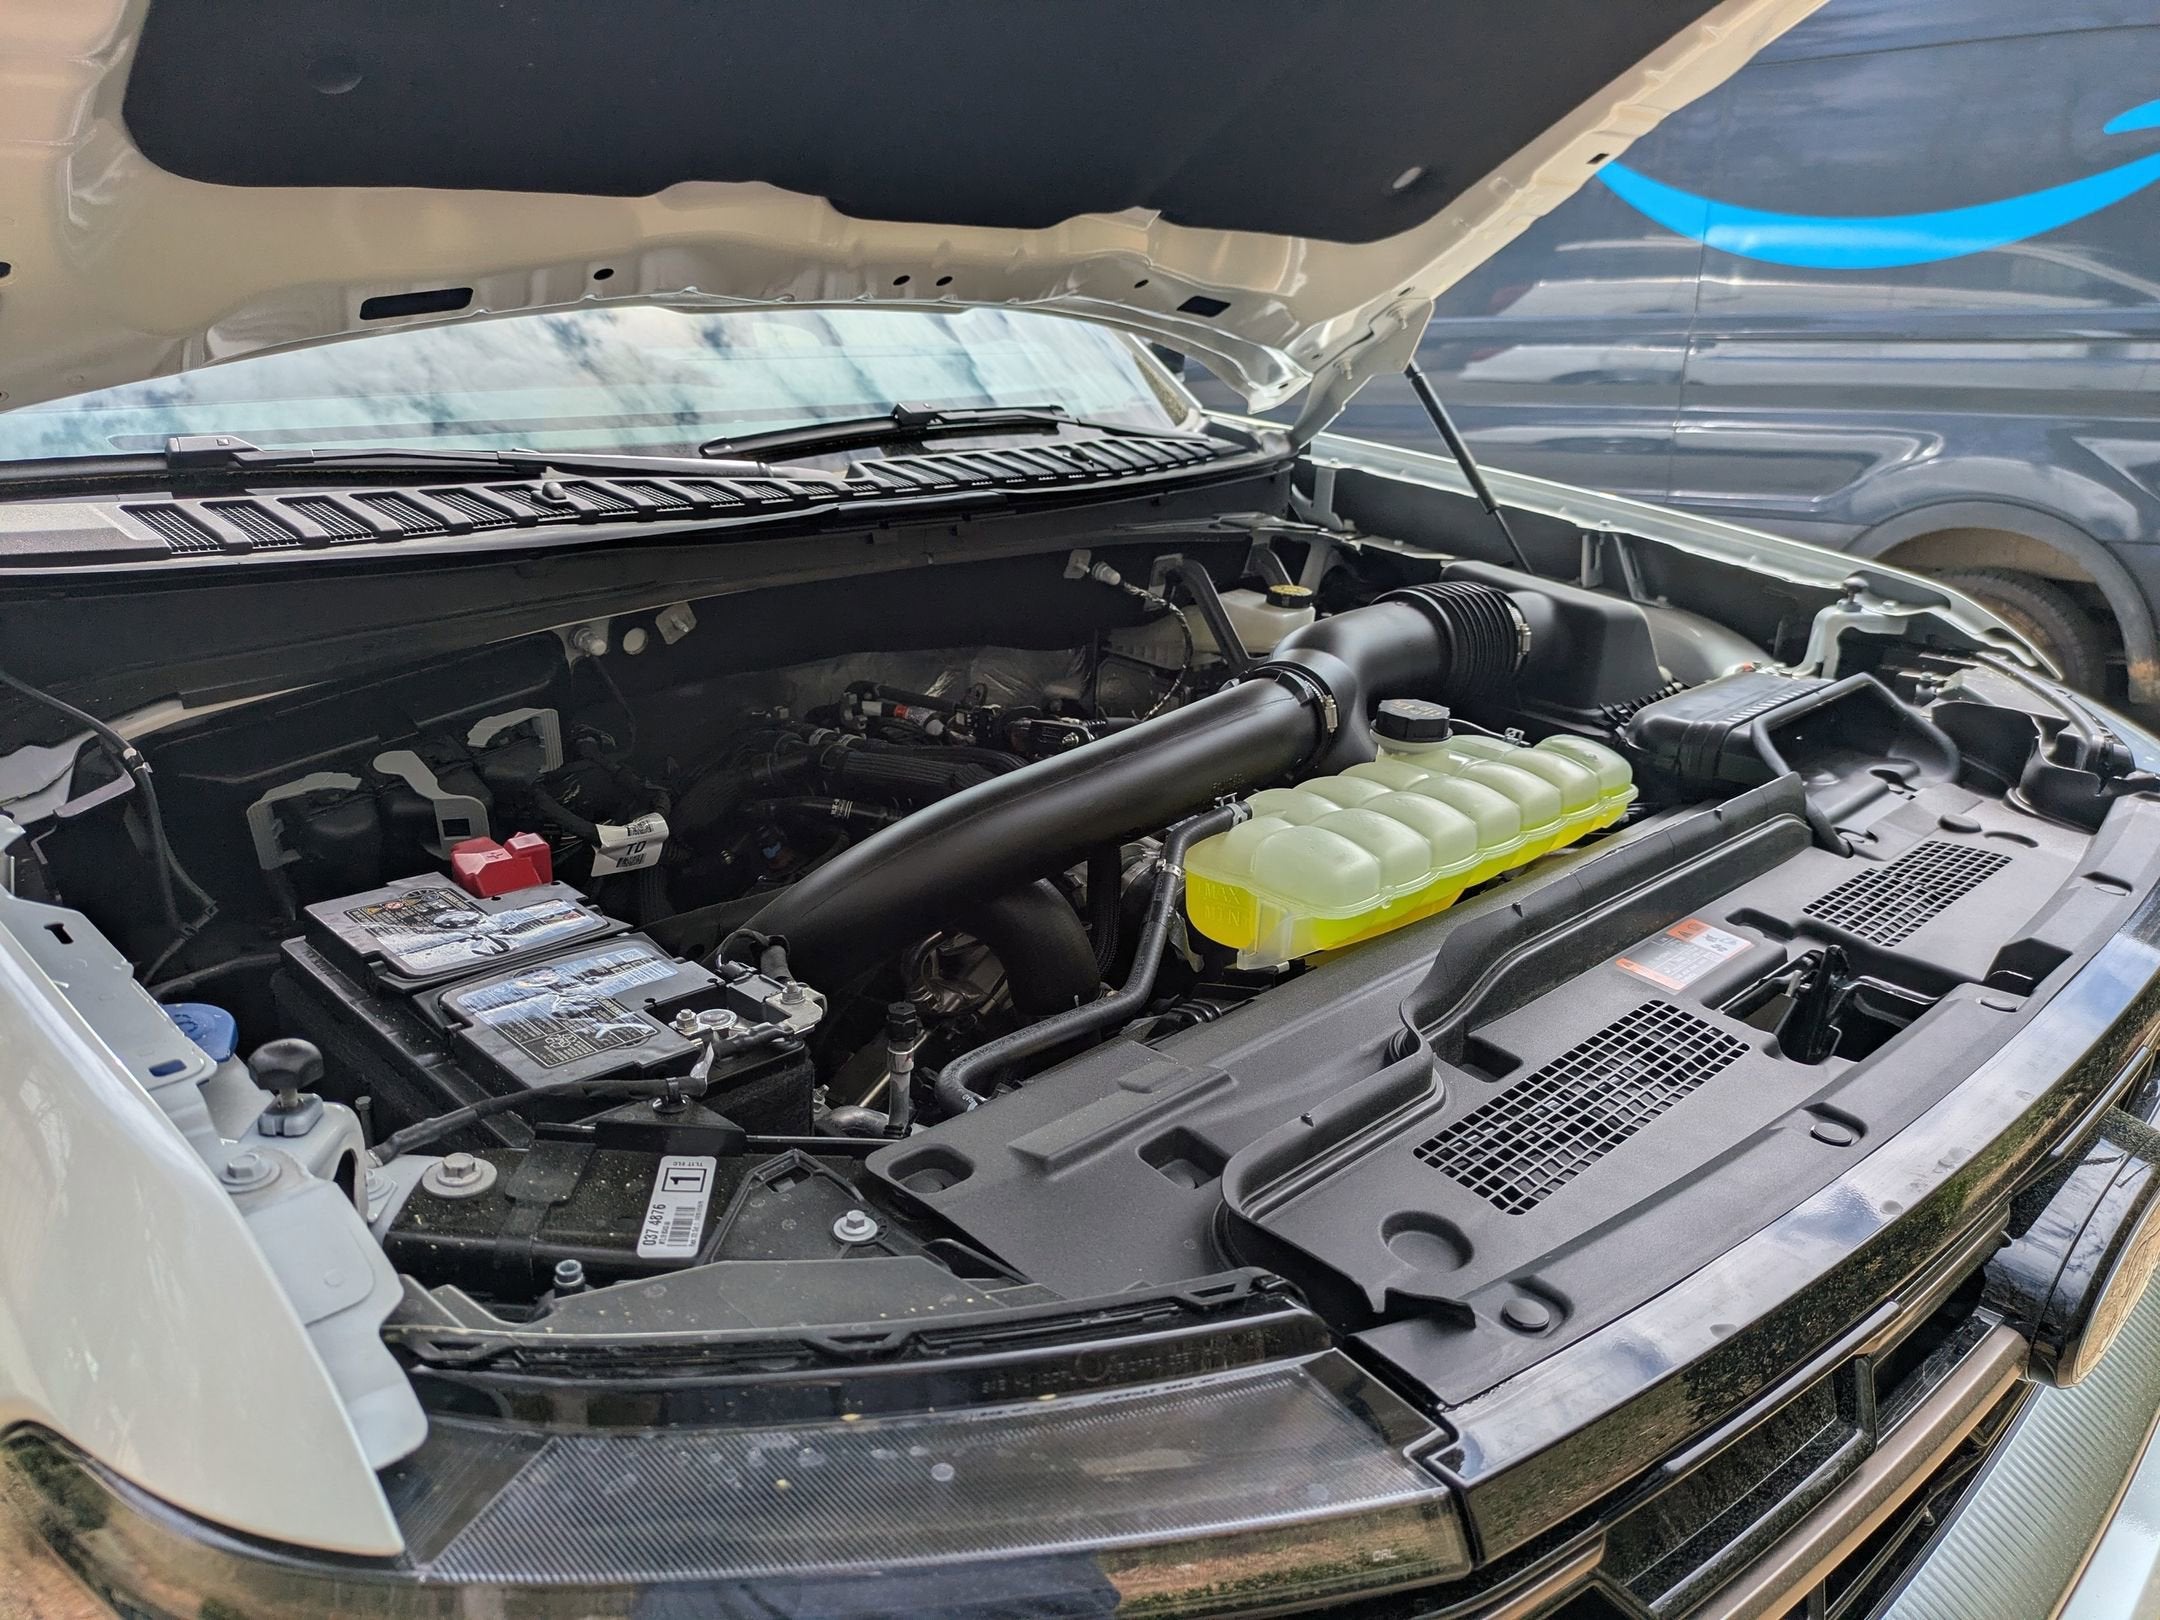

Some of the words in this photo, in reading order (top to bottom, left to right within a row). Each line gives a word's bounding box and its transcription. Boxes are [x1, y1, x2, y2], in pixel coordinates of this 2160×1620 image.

[1202, 882, 1241, 904] MAX
[1202, 904, 1240, 928] MIN
[669, 1176, 700, 1185] 1
[648, 1203, 666, 1226] 4876
[642, 1229, 659, 1246] 037
[1372, 1548, 1398, 1562] DRL
